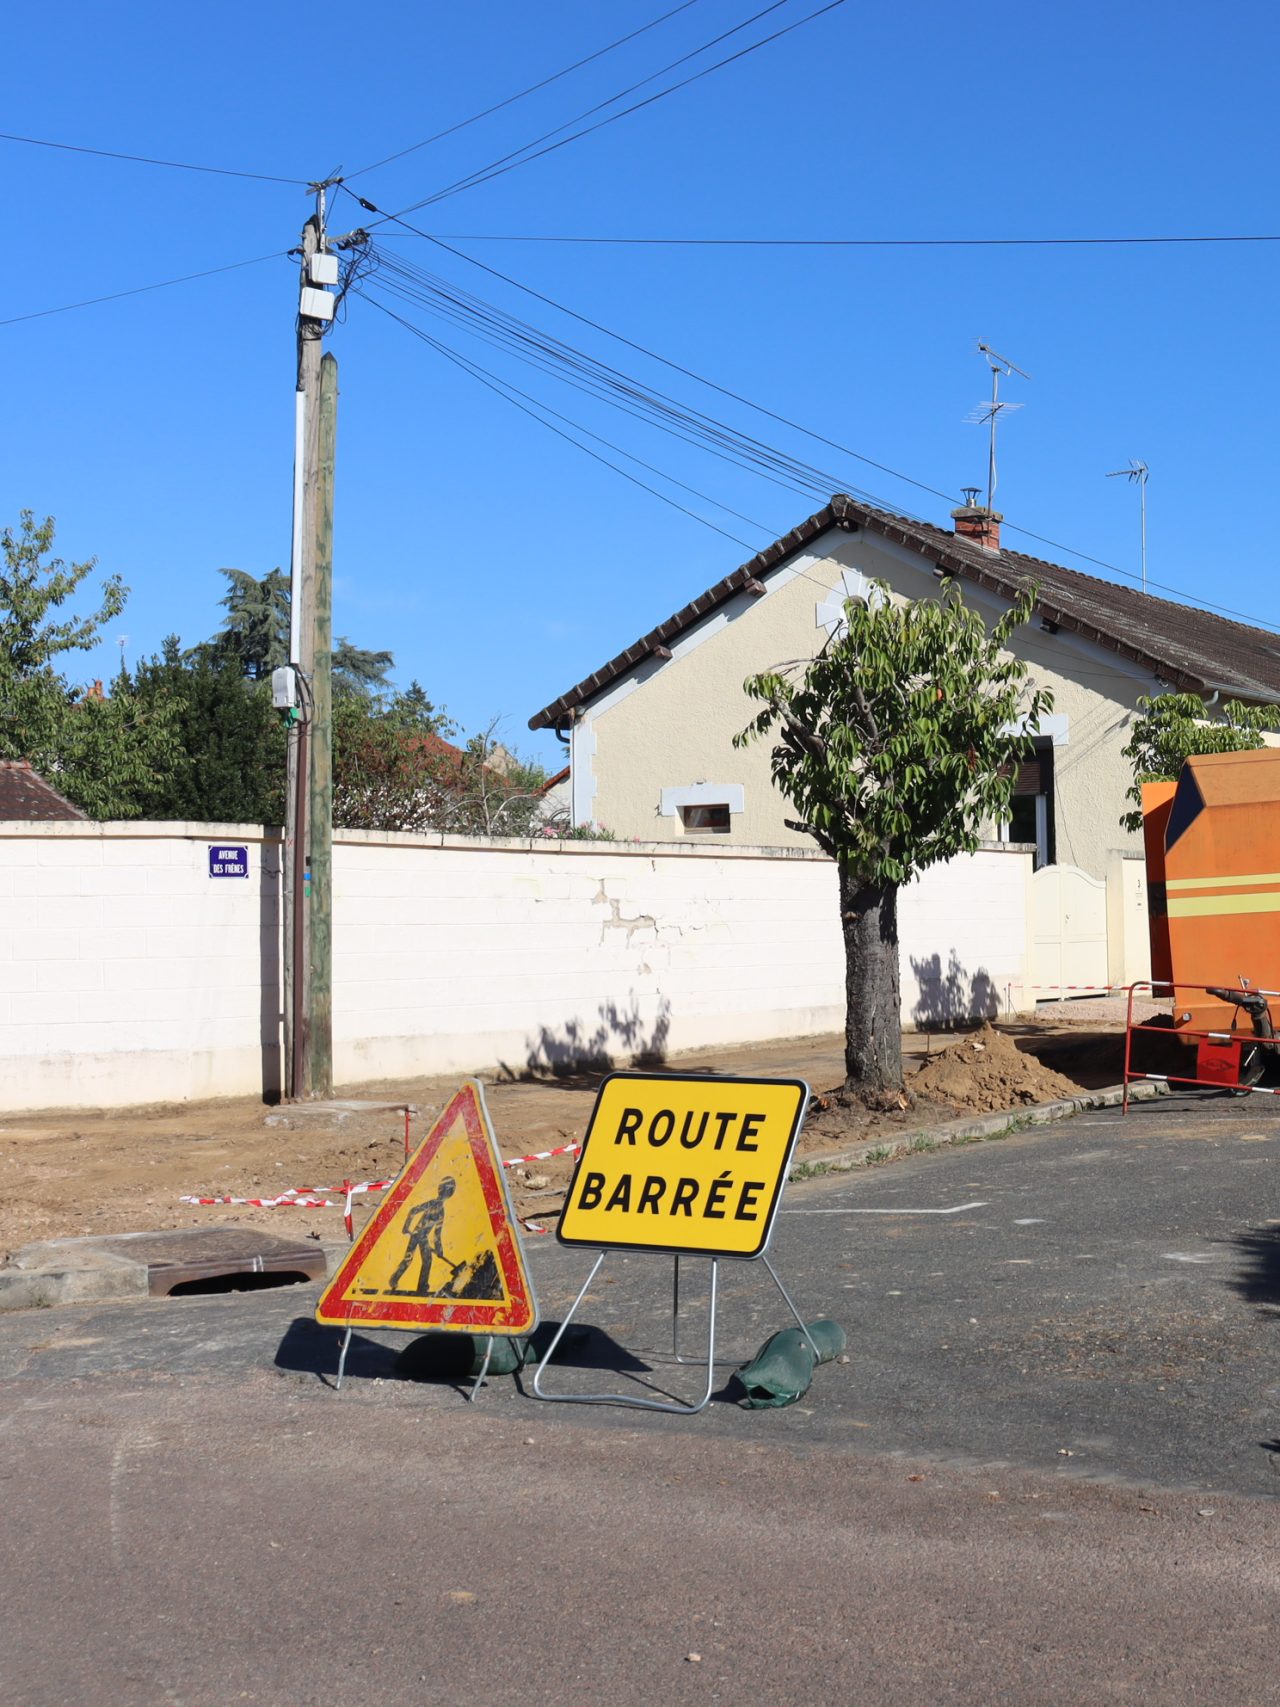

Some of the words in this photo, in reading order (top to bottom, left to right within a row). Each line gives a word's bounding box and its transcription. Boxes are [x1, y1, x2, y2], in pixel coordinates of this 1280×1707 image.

[213, 863, 223, 874] DES
[218, 850, 238, 860] AVENUE
[614, 1108, 766, 1152] ROUTE
[577, 1170, 766, 1221] BARRÉE
